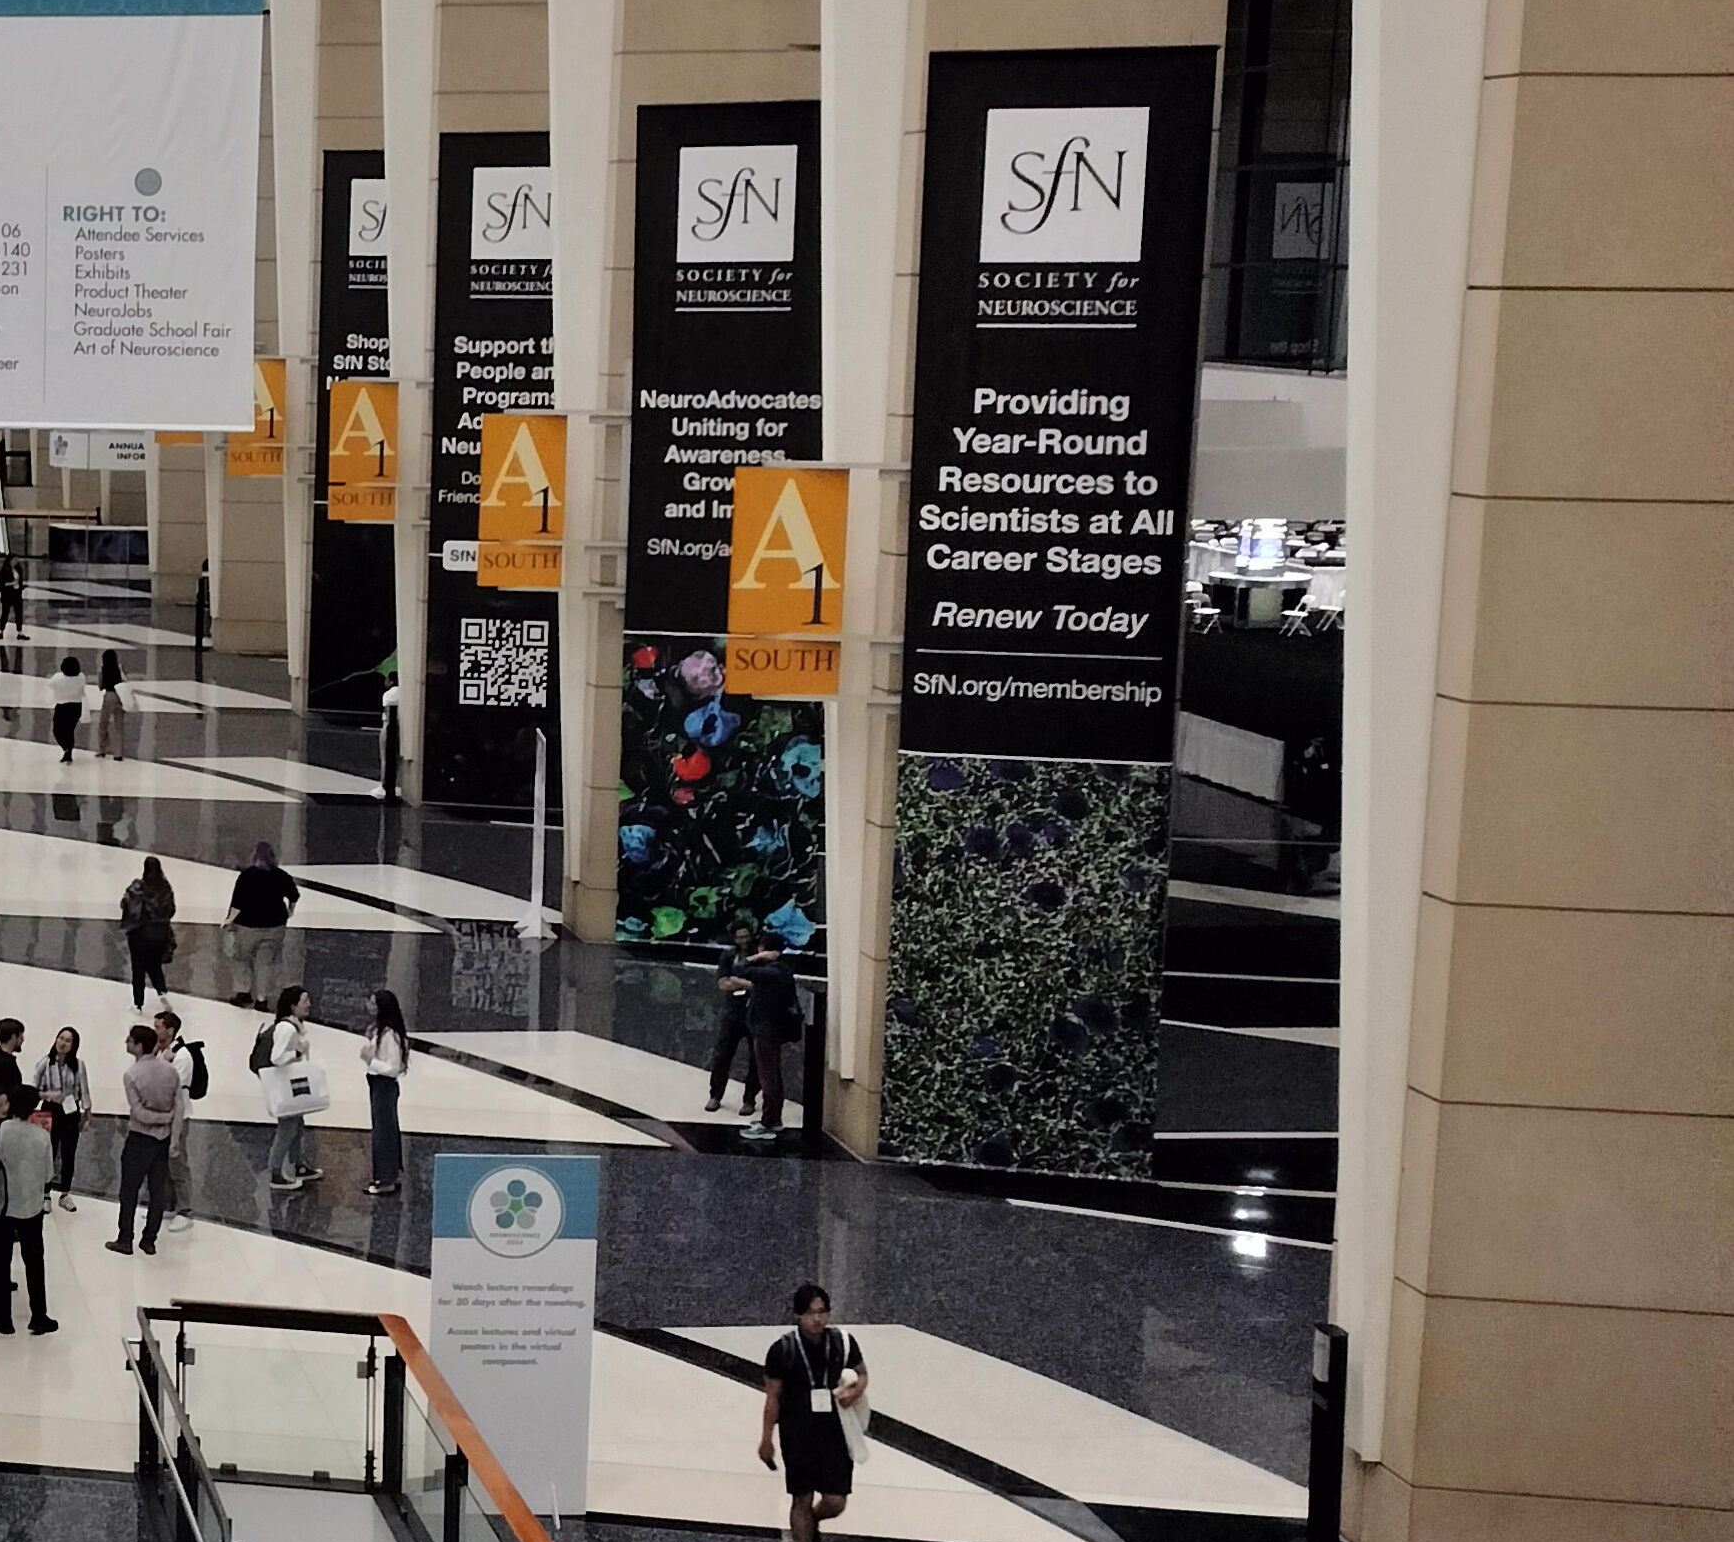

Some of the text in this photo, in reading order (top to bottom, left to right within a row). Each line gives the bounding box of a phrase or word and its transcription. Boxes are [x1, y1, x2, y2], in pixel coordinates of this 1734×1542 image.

[1000, 136, 1129, 234] SfN
[63, 205, 166, 223] RIGHT TO:
[482, 183, 552, 244] SfN
[691, 167, 782, 242] SfN
[75, 225, 205, 243] Attendee Services
[75, 245, 125, 261] Posters
[75, 262, 131, 280] Exhibits
[470, 264, 538, 275] SOCIETY
[675, 268, 794, 285] SOCIETY for
[74, 281, 189, 300] Product Theater
[978, 272, 1140, 293] SOCIETY for
[675, 289, 792, 303] NEUROSCIENCE
[74, 301, 153, 318] NeuroJobs
[977, 299, 1138, 317] NEUROSCIENCE
[73, 320, 233, 338] Graduate School Fair
[73, 338, 220, 357] Art of Neuroscience
[346, 333, 389, 352] Shop
[453, 335, 536, 358] Support
[333, 354, 362, 370] SfN
[456, 361, 526, 383] People
[640, 389, 822, 410] NeuroAdvocates
[973, 387, 1131, 422] Providing
[329, 387, 395, 456] A
[671, 417, 788, 441] Uniting for
[952, 426, 1148, 456] Year-Round
[230, 451, 283, 463] SOUTH
[371, 439, 389, 477] 1
[480, 421, 562, 507] A
[937, 466, 1159, 496] Resources to
[332, 491, 393, 506] SOUTH
[533, 485, 554, 534] 1
[664, 500, 706, 519] and
[918, 504, 1175, 536] Scientists at All
[732, 477, 841, 590] A
[647, 538, 732, 561] SfN.org/a
[484, 552, 560, 569] SOUTH
[926, 543, 1162, 580] Career Stages
[801, 562, 831, 626] 1
[931, 601, 1149, 640] Renew Today
[735, 648, 833, 671] SOUTH
[913, 673, 1162, 707] SfN.org/membership
[525, 1298, 541, 1306] the
[522, 1327, 541, 1336] and
[511, 1342, 527, 1351] the
